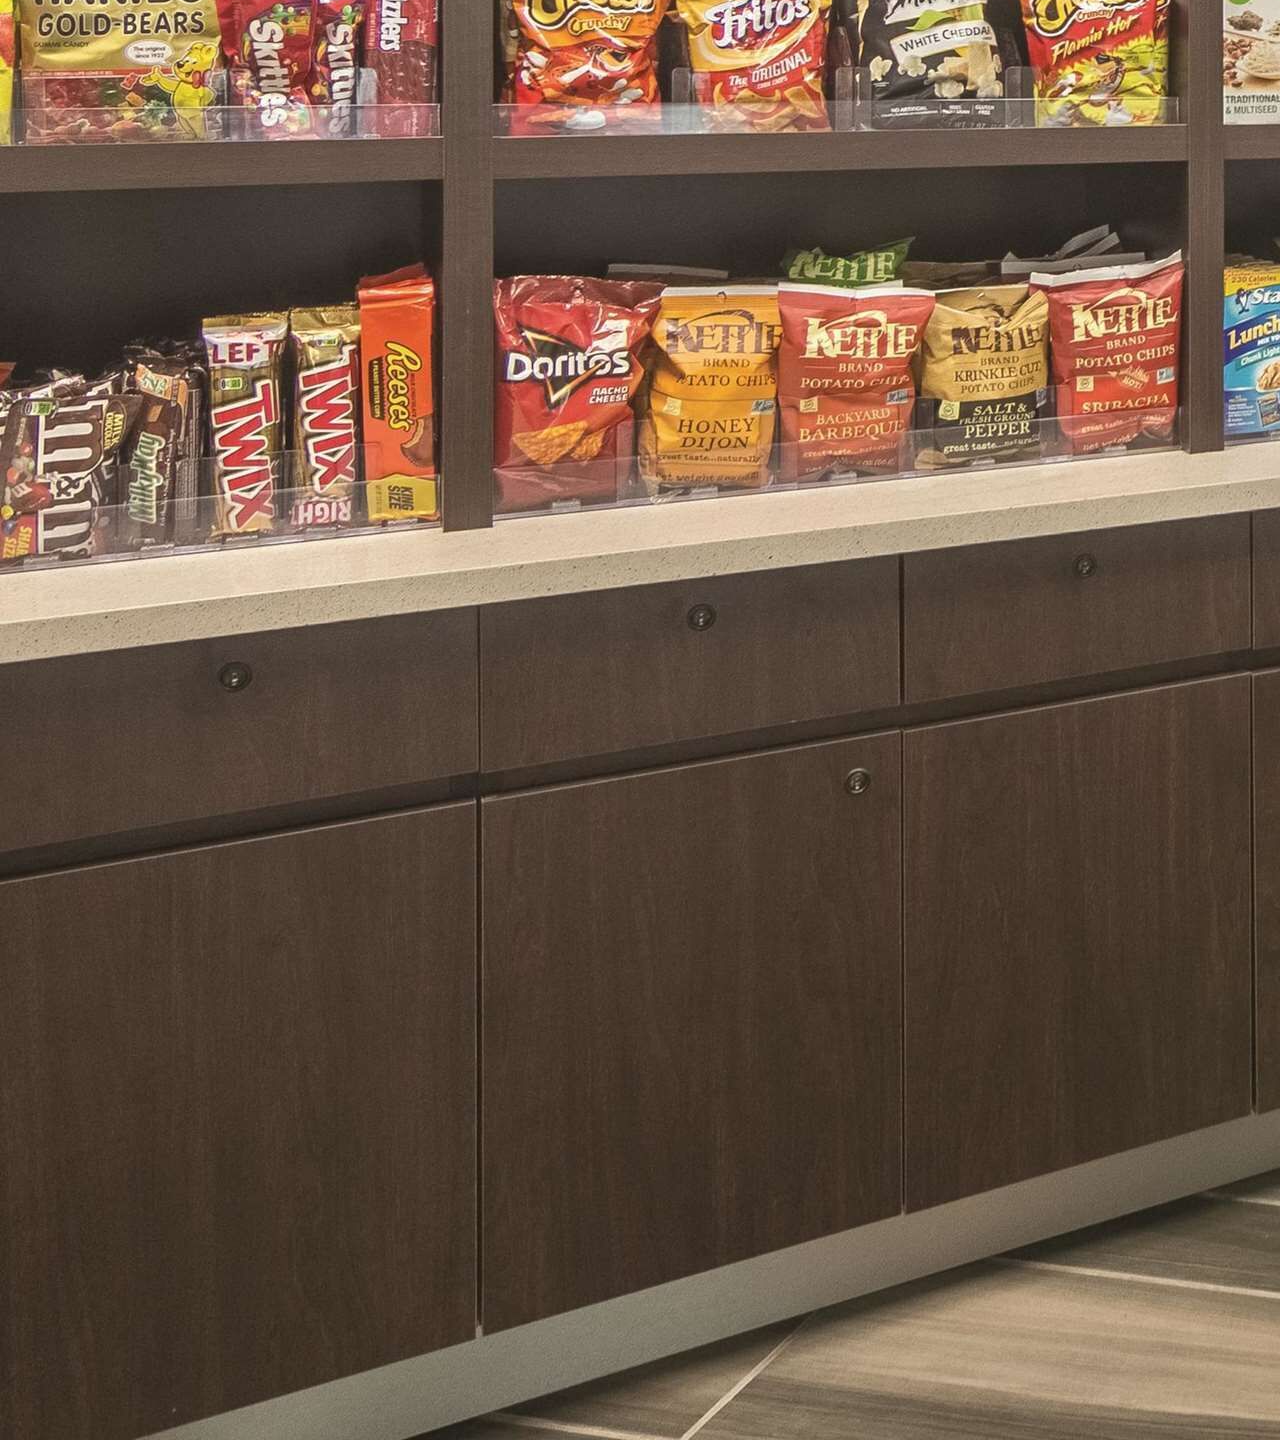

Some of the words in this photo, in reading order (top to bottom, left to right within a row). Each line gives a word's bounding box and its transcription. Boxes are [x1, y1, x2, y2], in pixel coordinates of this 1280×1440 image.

[38, 11, 204, 36] GOLD-BEARS
[568, 15, 631, 36] Crunchy
[1106, 13, 1142, 36] Hot
[899, 33, 940, 52] WHITE
[751, 52, 812, 83] ORIGINAL
[1234, 105, 1278, 114] MULTISEED
[1070, 287, 1178, 343] KETTLE
[799, 311, 919, 359] KETTLE
[1106, 335, 1146, 350] BRAND
[506, 351, 631, 381] Doritos
[703, 359, 750, 368] BRAND
[1075, 353, 1133, 369] POTATO
[1137, 344, 1175, 361] CHIPS
[839, 363, 884, 373] BRAND
[954, 369, 1018, 382] KRINKLE
[592, 386, 628, 396] NACHO
[800, 378, 865, 389] POTATO
[588, 393, 628, 404] CHEESE
[1082, 394, 1170, 415] SRIRACHA
[301, 345, 359, 493] TWIX
[816, 408, 892, 425] BACKYARD
[973, 403, 1014, 415] SALT
[110, 410, 124, 450] MILK
[678, 418, 756, 432] HONEY
[799, 419, 905, 441] BARBEQUE
[964, 421, 1030, 438] PEPPER
[680, 437, 750, 451] DIJON
[213, 380, 281, 529] TWIX
[400, 486, 414, 512] KING
